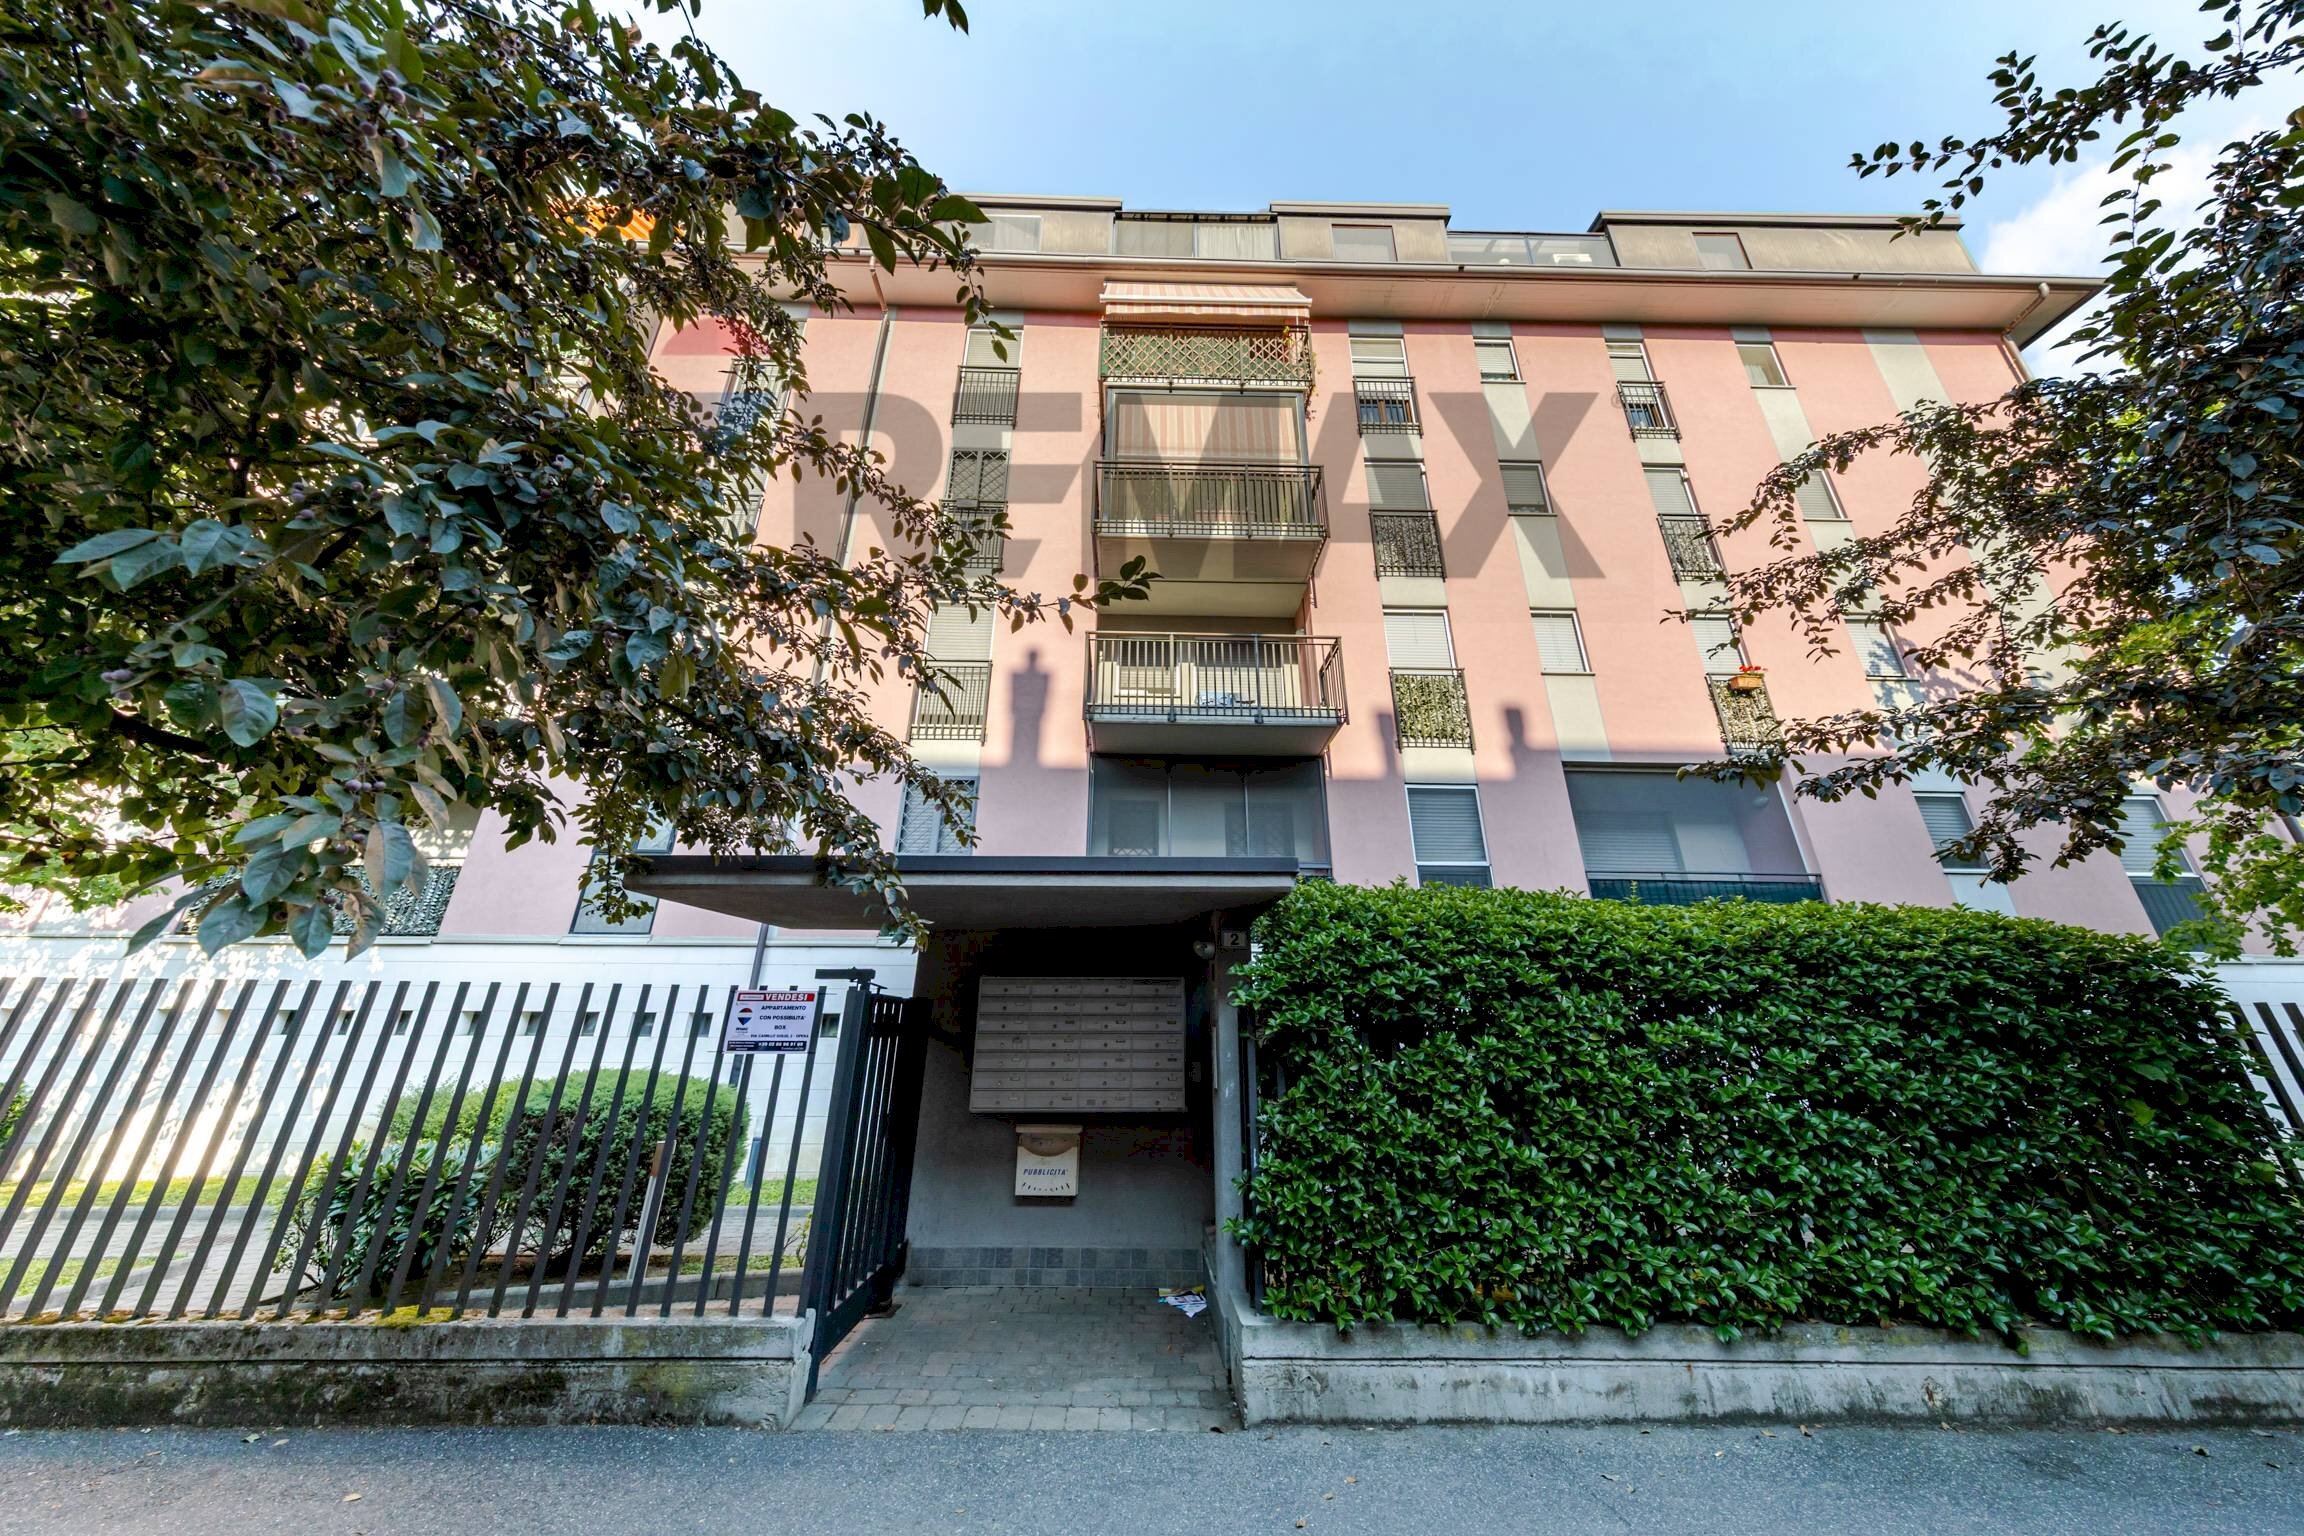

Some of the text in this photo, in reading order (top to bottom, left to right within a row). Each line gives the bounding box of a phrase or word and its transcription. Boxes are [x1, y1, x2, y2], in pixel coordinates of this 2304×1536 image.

[1230, 933, 1239, 945] 2
[765, 993, 808, 1001] VENDESI
[1023, 1168, 1069, 1176] PUBBLICITA'
